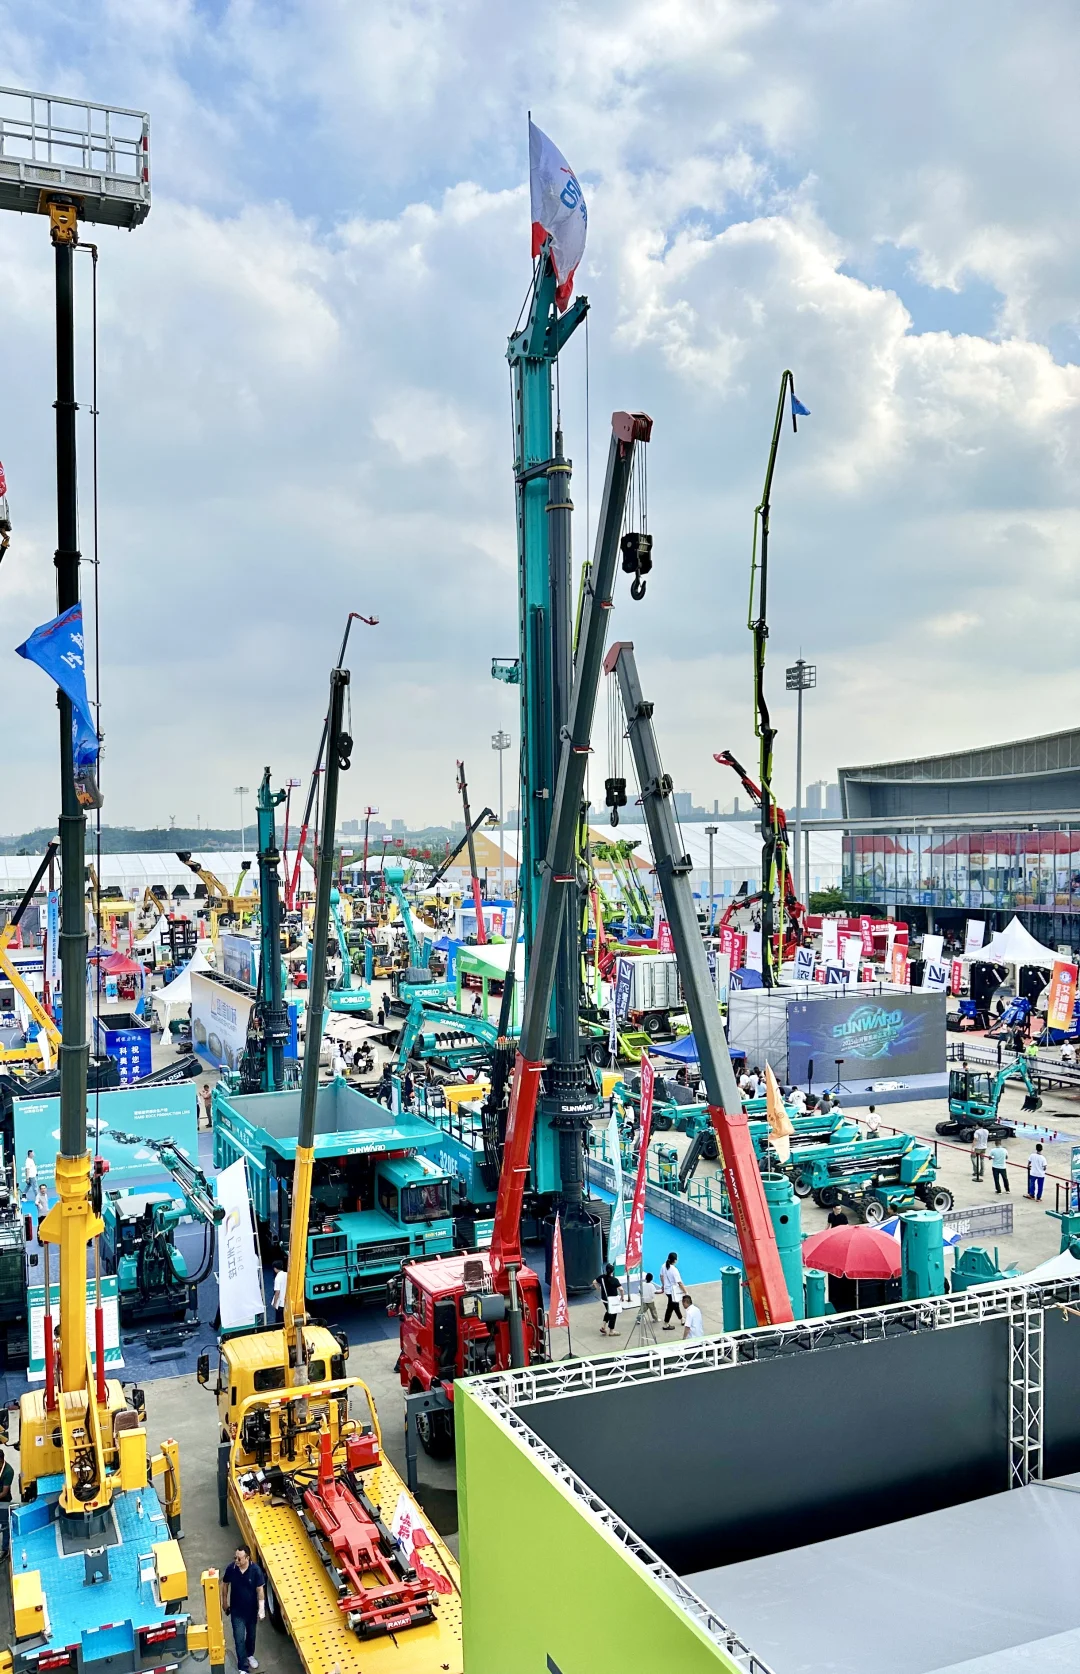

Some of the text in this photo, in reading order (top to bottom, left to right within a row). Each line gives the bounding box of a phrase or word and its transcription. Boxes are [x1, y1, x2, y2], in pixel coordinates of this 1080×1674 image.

[415, 989, 440, 997] KOBELCO
[832, 1007, 902, 1038] SUNWARD
[561, 1102, 594, 1112] SUNWARD
[347, 1142, 386, 1154] SUNWARD
[729, 1168, 740, 1199] RAYAT
[387, 1618, 410, 1629] RAYAT
